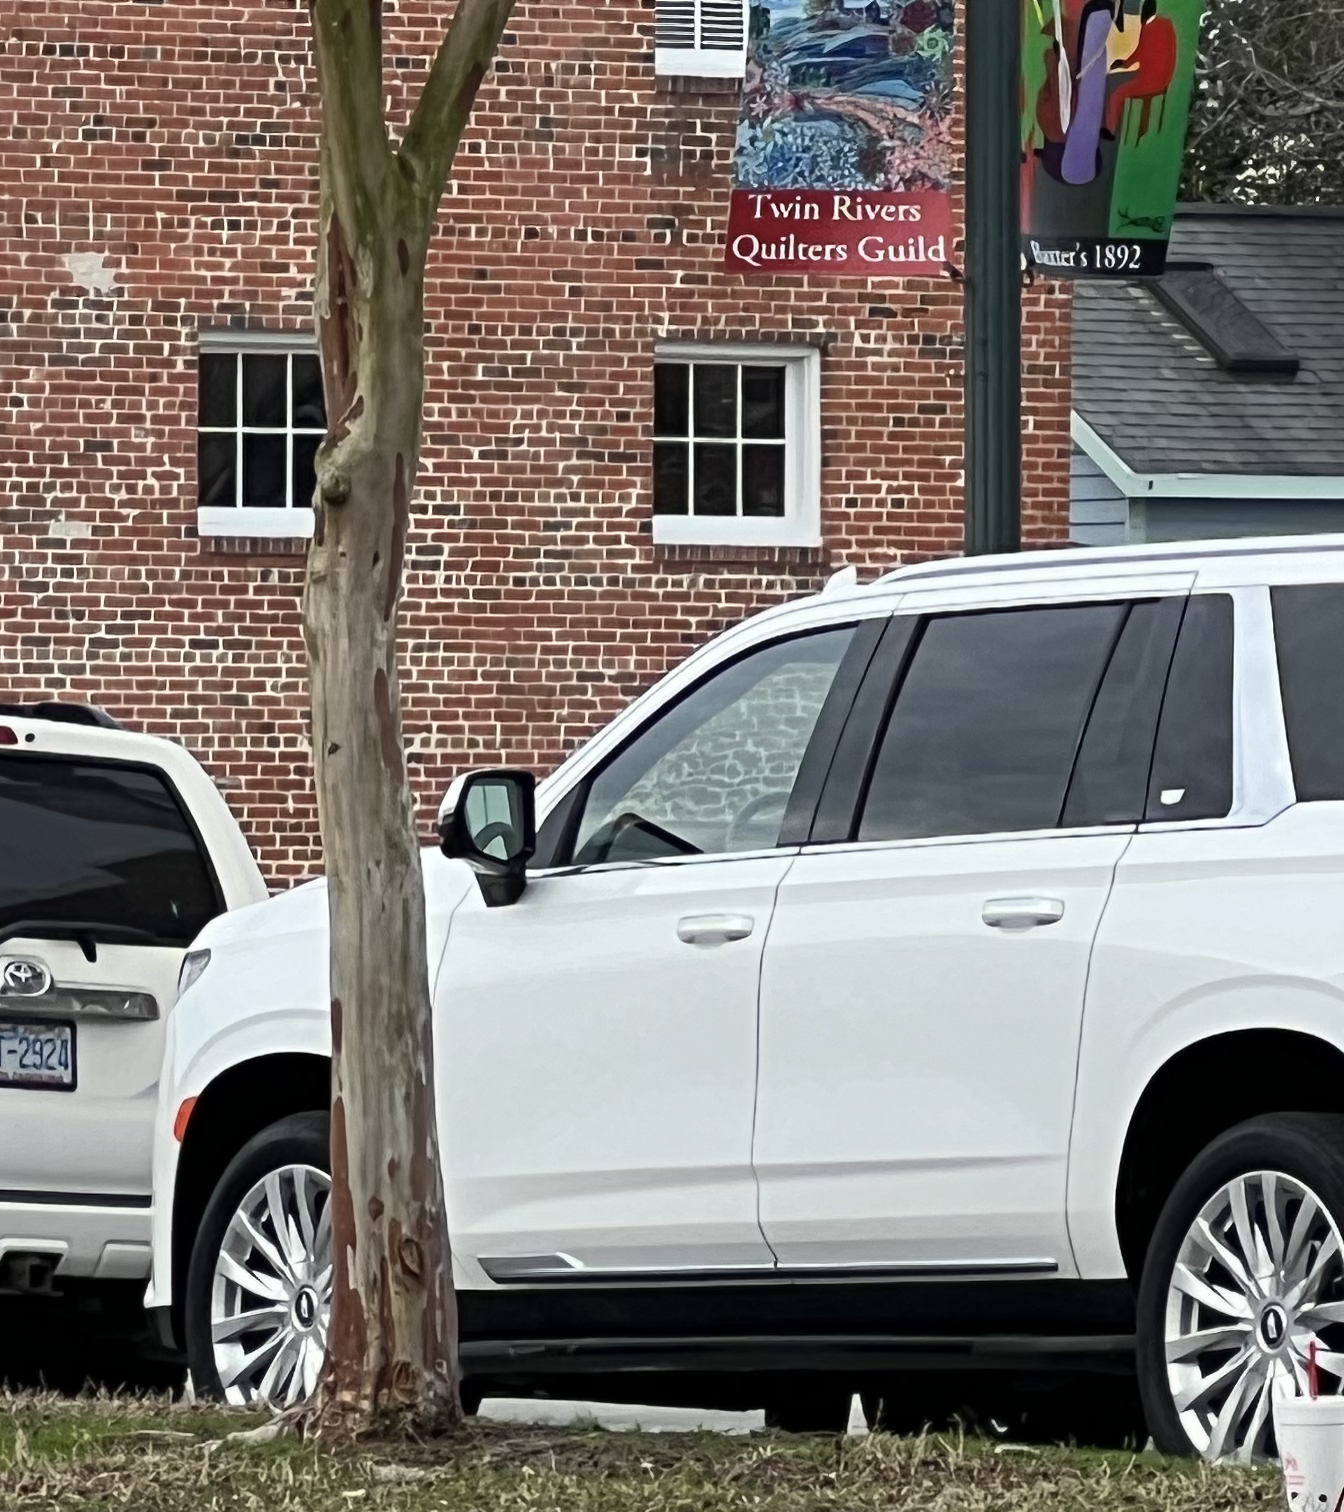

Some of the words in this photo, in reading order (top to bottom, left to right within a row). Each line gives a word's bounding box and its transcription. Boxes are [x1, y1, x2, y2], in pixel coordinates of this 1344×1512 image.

[748, 194, 820, 220] Twin
[832, 194, 922, 222] Rivers
[732, 233, 848, 267] Quilters
[857, 235, 948, 263] Guild
[1095, 244, 1141, 270] 1892
